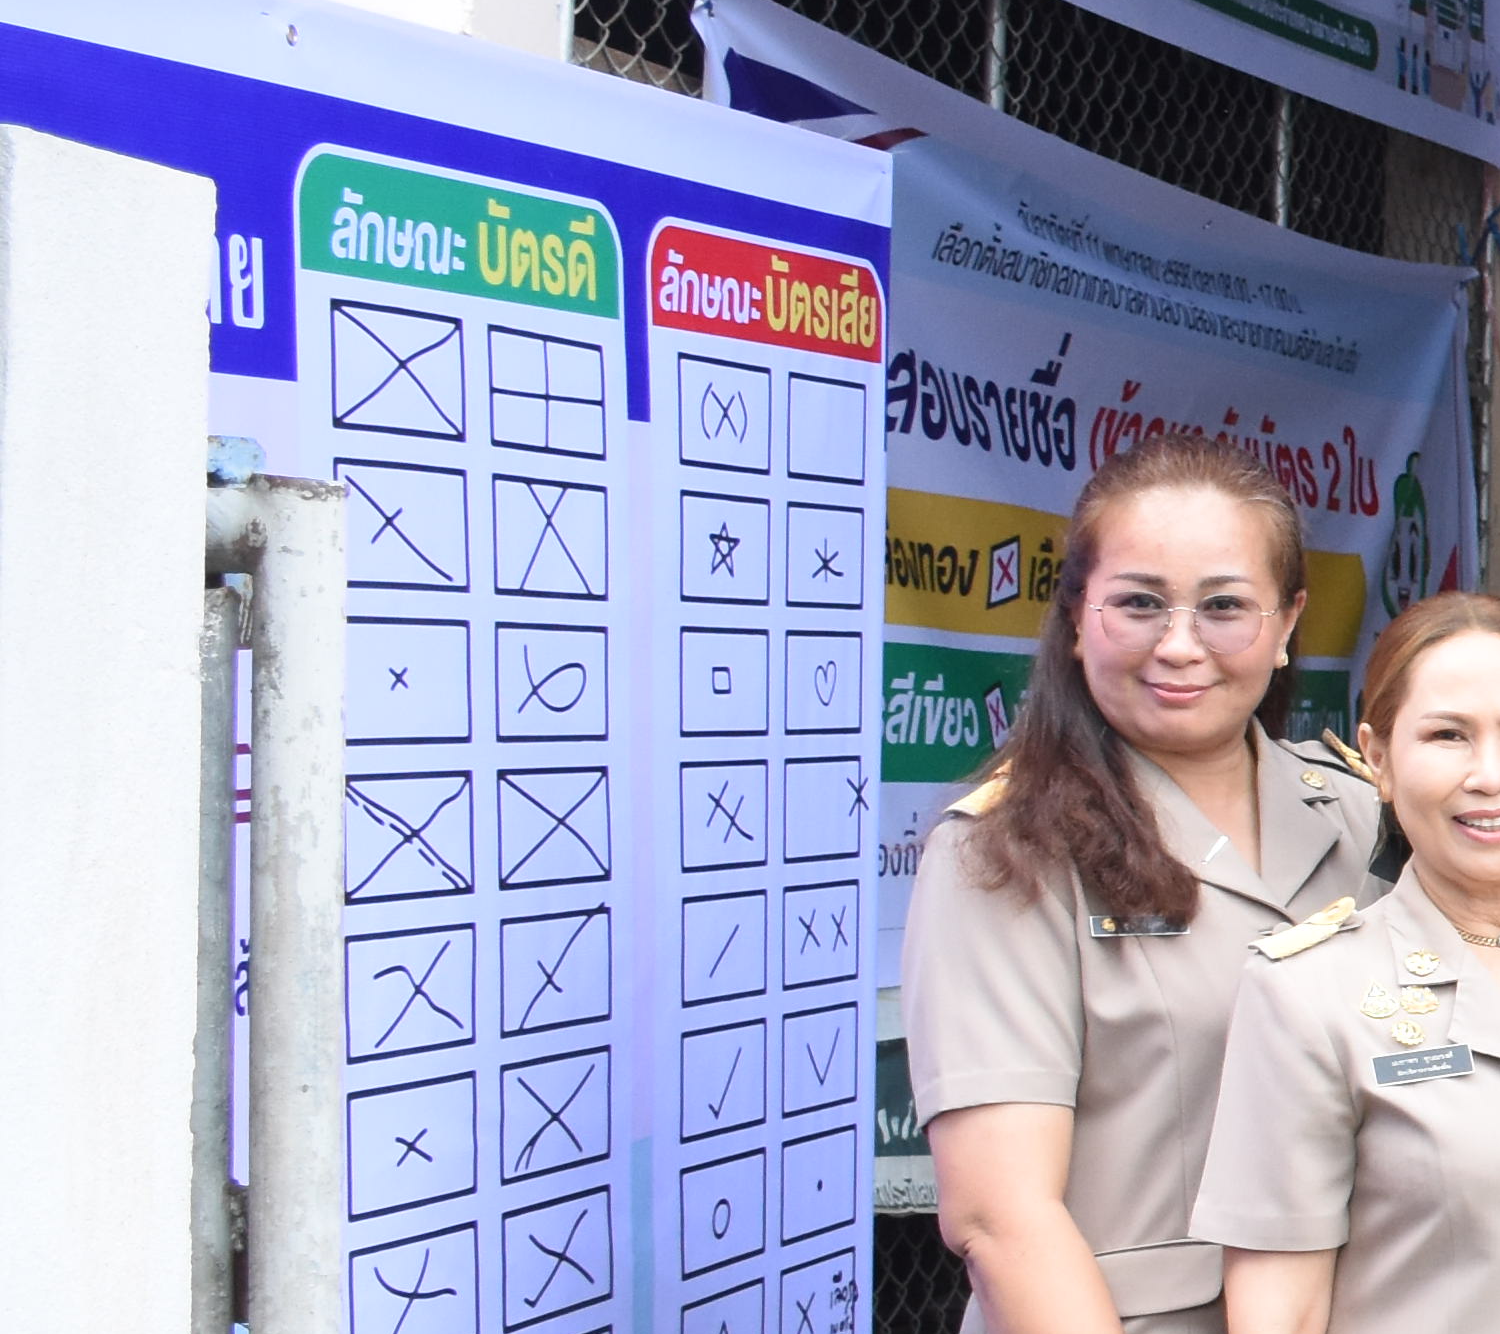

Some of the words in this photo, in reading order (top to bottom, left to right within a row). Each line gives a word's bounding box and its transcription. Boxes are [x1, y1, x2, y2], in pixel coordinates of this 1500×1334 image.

[331, 187, 467, 276] ลักษณะ
[477, 198, 599, 302] บัตรดี
[659, 248, 763, 325] ลักษณะ
[765, 253, 878, 349] บัตรเสีย
[1322, 441, 1341, 513] 2
